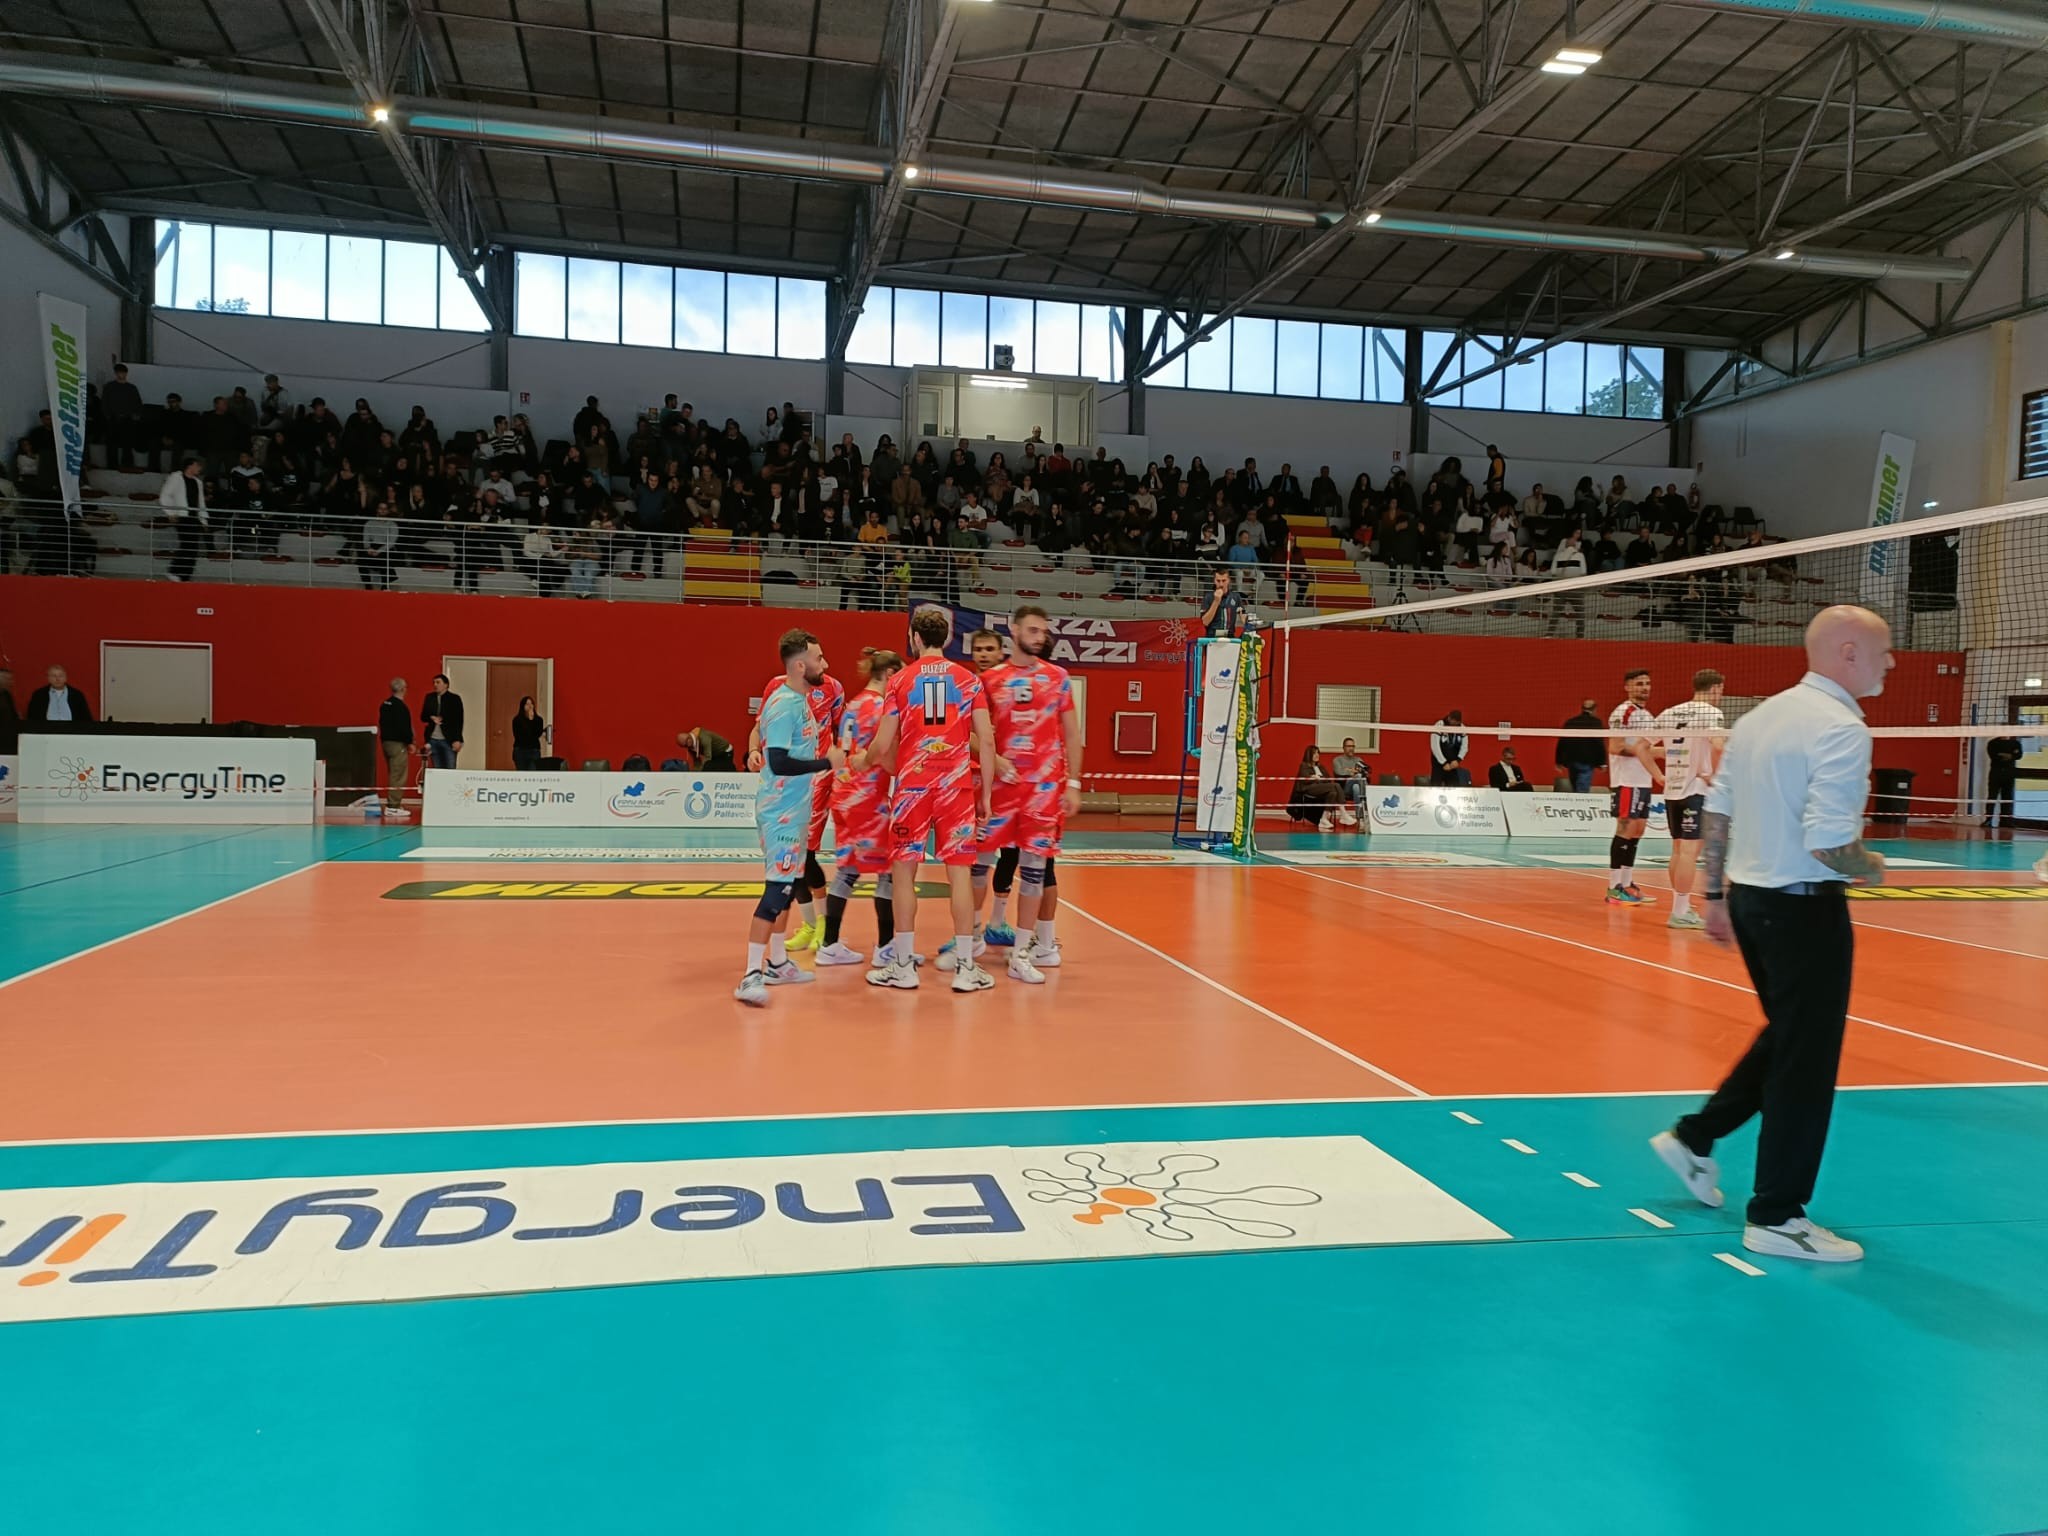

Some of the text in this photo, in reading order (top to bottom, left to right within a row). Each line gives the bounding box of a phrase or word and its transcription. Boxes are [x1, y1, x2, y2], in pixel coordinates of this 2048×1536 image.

[51, 322, 83, 476] metamer
[1868, 453, 1900, 576] mamer
[923, 681, 946, 725] 11
[1233, 641, 1248, 846] CREDEM BANCA CREDEM BANCA
[102, 764, 286, 799] EnergyTime
[477, 788, 575, 806] EnergyTime
[714, 801, 745, 809] Italiana
[714, 810, 753, 818] Pallavolo
[1461, 820, 1493, 828] Pallavolo
[1544, 805, 1612, 821] EnergyTim
